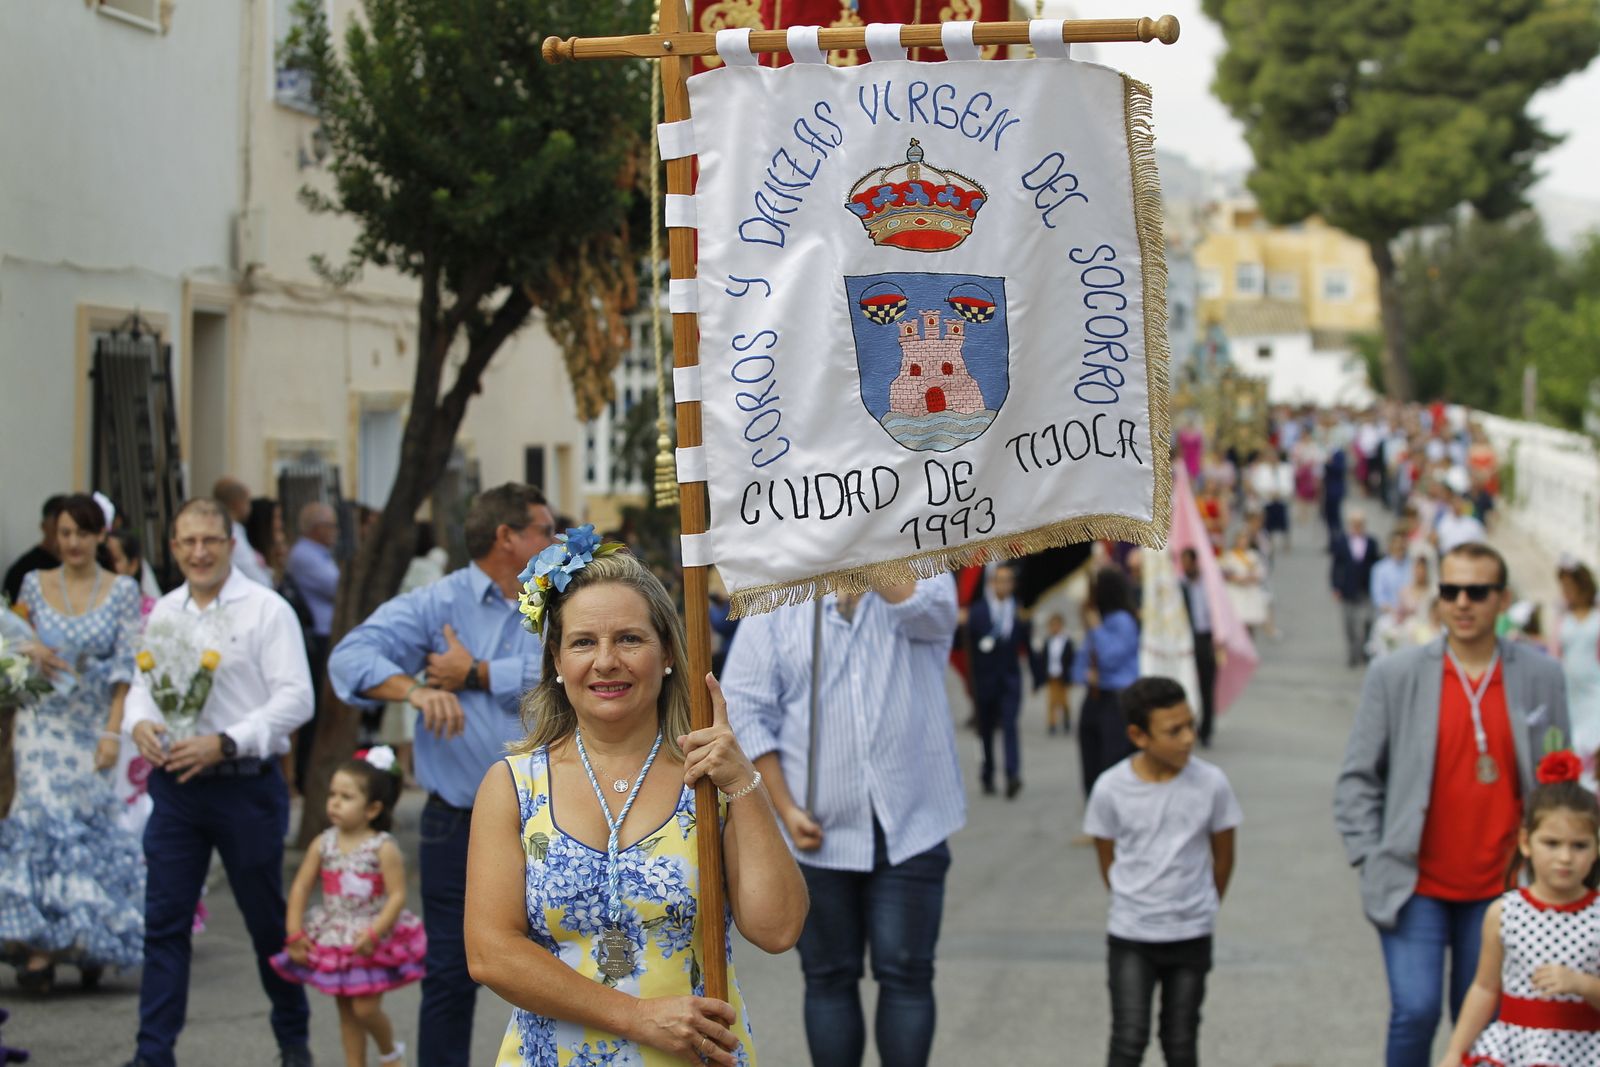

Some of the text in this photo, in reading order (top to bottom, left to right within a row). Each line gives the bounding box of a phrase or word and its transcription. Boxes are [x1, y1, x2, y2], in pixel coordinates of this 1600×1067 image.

[725, 80, 1129, 468] COROS Y DANZAS VIRGEN DEL SOCORRO
[740, 413, 1143, 525] CIUDAD DE TIJOLA
[900, 497, 997, 549] 1993
